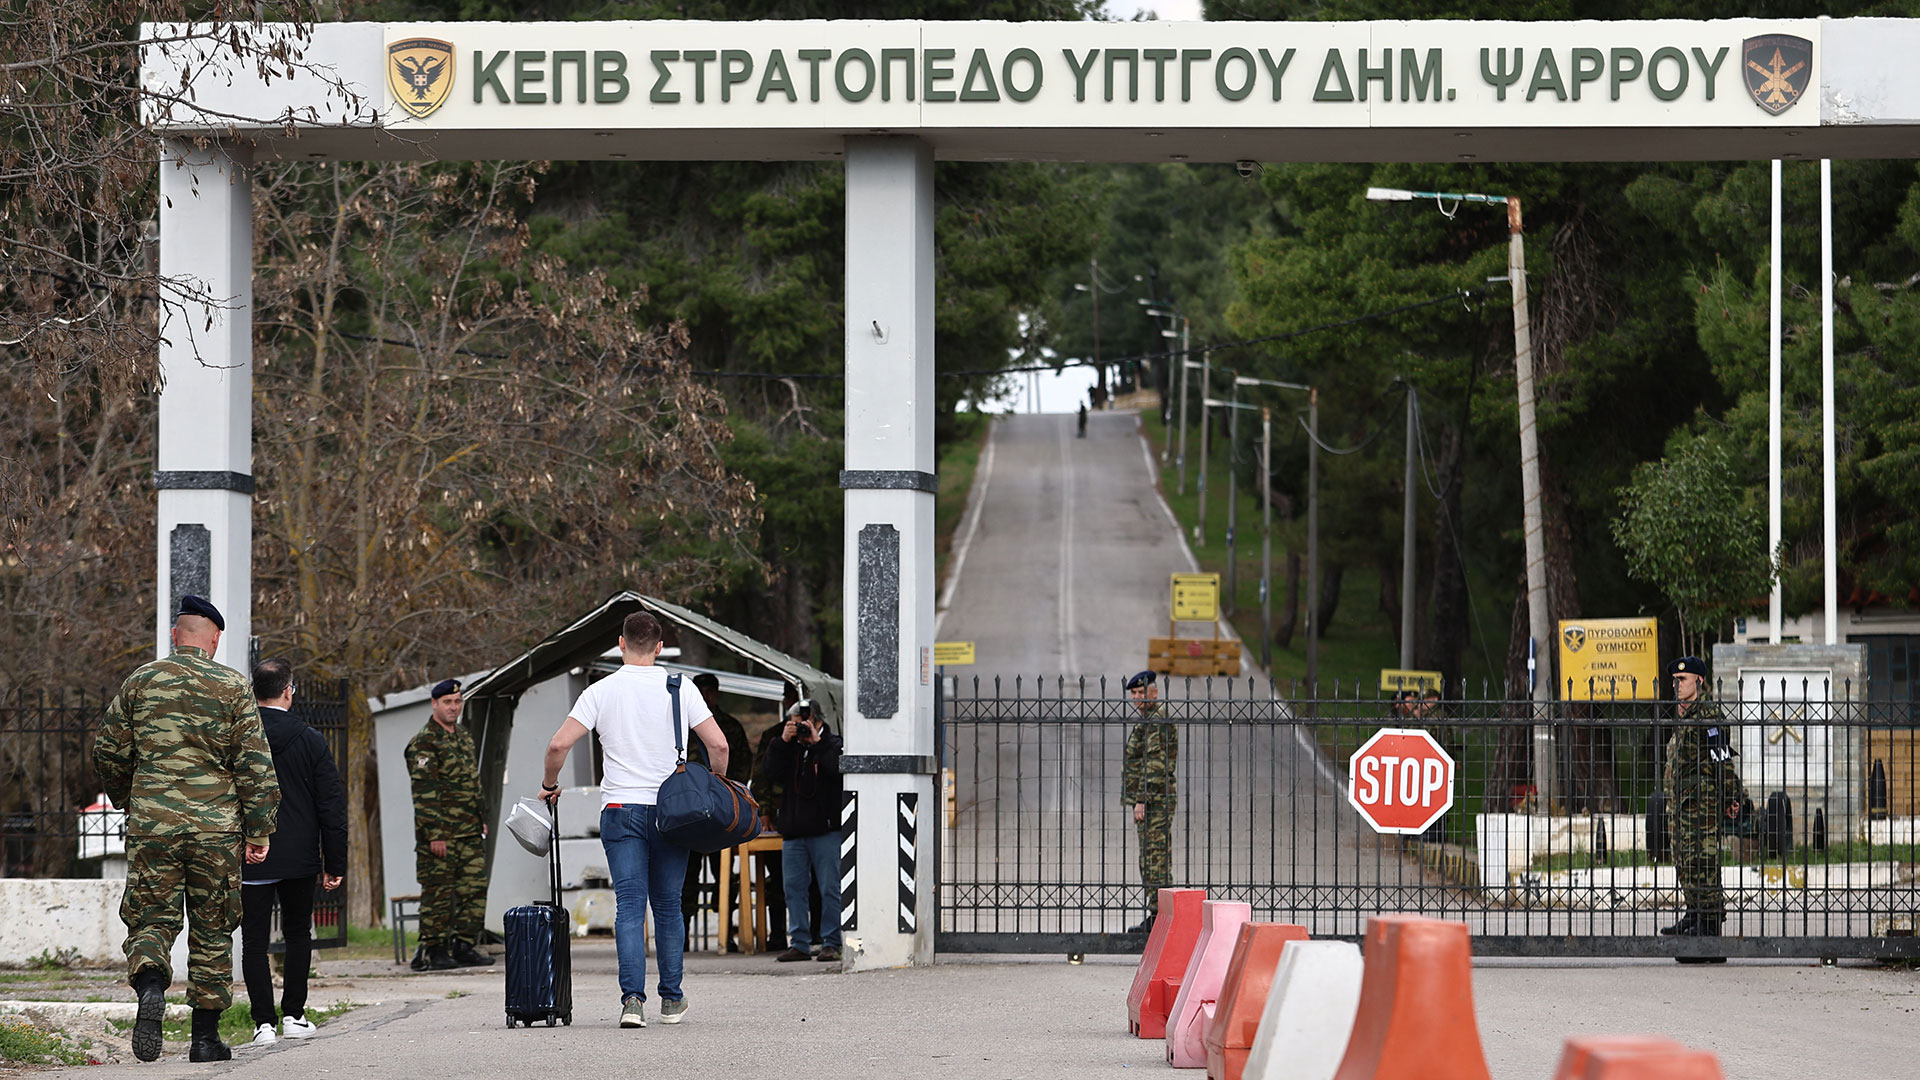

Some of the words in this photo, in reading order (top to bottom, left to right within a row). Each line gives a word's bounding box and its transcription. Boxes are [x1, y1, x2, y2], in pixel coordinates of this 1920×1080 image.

[472, 50, 630, 105] ΚΕΠΒ
[649, 47, 1044, 105] ΣΤΡΑΤΟΠΕΔΟ
[1061, 47, 1297, 103] ΥΠΤΓΟΥ
[1312, 47, 1457, 103] ΔΗΜ.
[1479, 46, 1729, 103] ΨΑΡΡΟΥ
[1588, 627, 1654, 638] ΠΥΡΟΒΟΛΗΤΑ
[1596, 642, 1647, 653] ΘΥΜΗΣΟΥ!
[1591, 661, 1617, 671] ΕΙΜΑΙ
[1359, 755, 1444, 807] STOP
